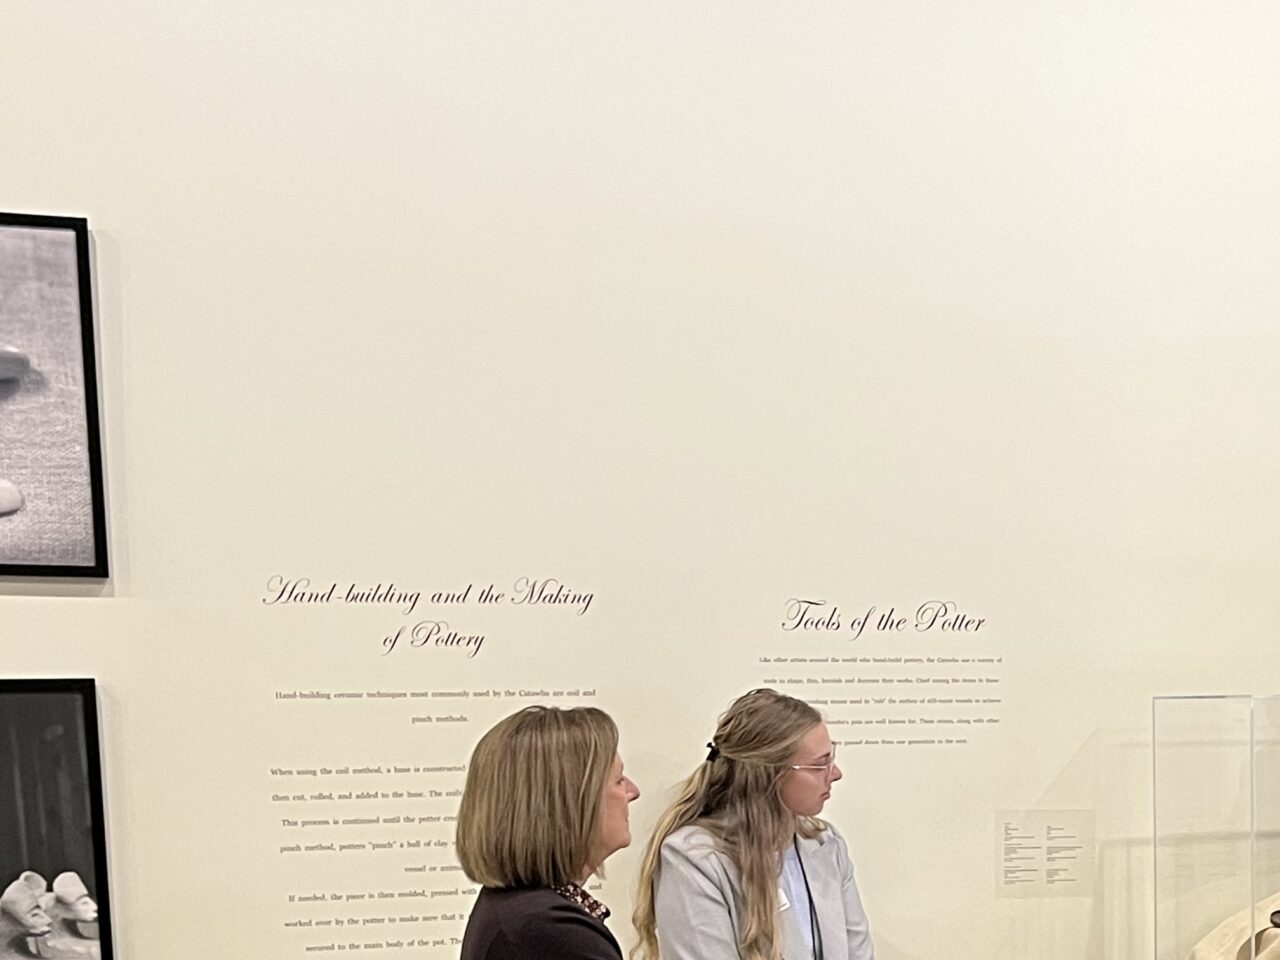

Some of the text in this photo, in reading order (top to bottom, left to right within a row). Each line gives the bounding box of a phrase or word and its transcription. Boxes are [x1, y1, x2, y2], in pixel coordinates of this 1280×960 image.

[262, 574, 594, 616] Hand-building and the Making
[381, 620, 485, 659] of Pottery
[781, 598, 986, 642] Tools of the Potter
